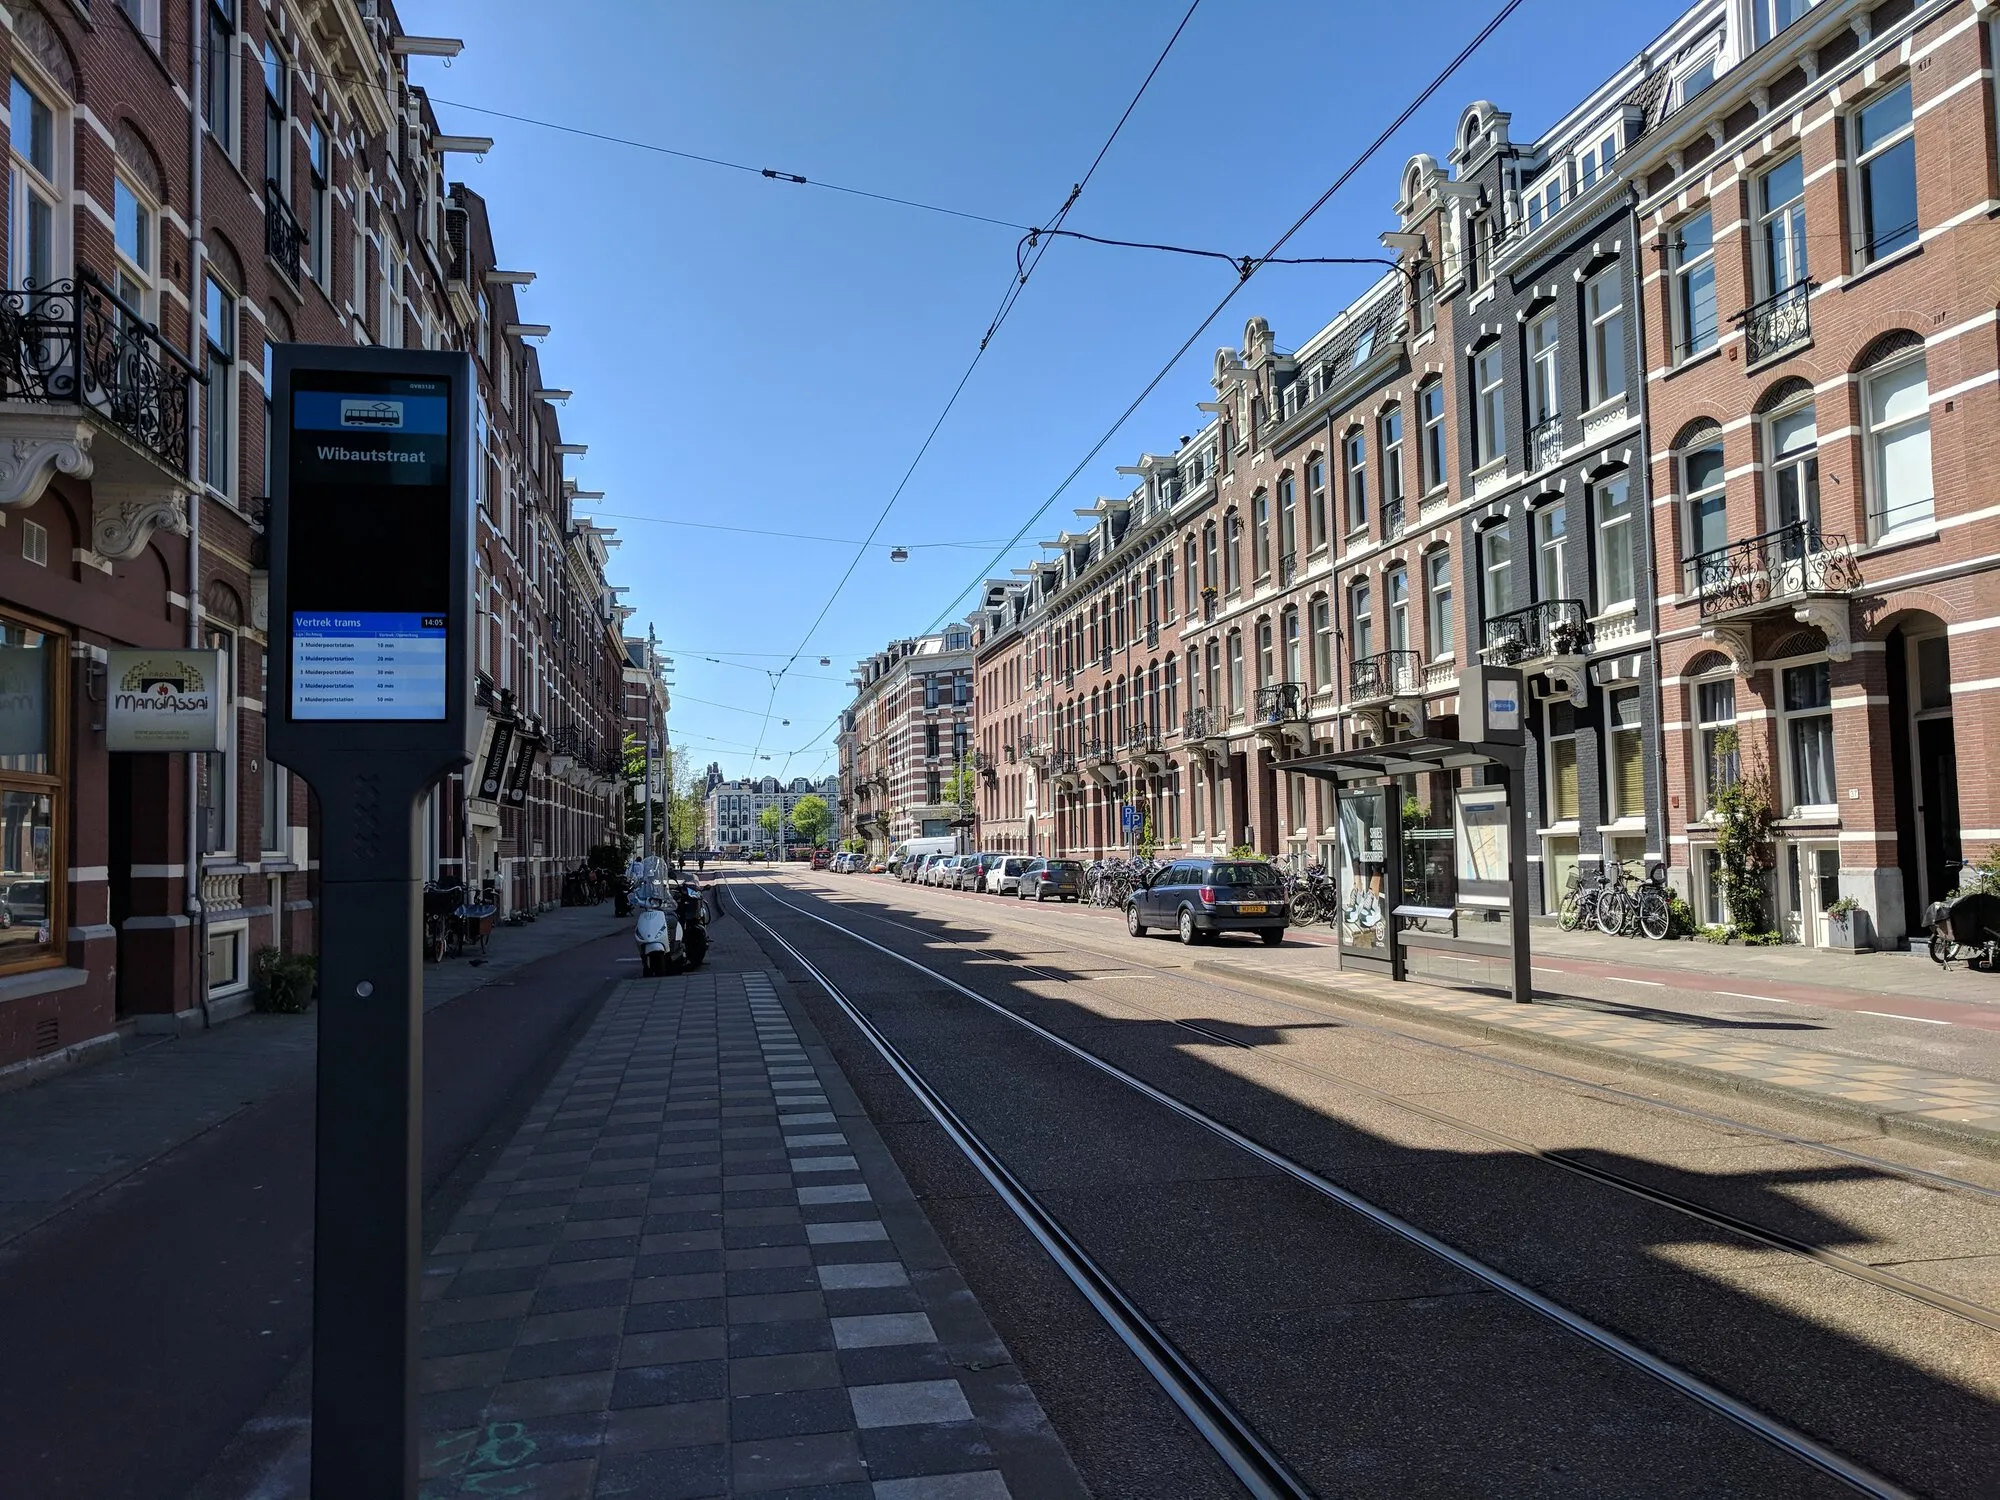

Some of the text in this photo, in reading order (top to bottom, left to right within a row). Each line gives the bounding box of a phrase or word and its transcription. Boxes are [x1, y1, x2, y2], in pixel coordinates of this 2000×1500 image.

[317, 446, 426, 463] Wibautstraat
[296, 618, 361, 627] Vertrek trams
[488, 730, 508, 778] WARSTEINER
[515, 744, 532, 788] WARSTEINER
[1132, 814, 1140, 824] P
